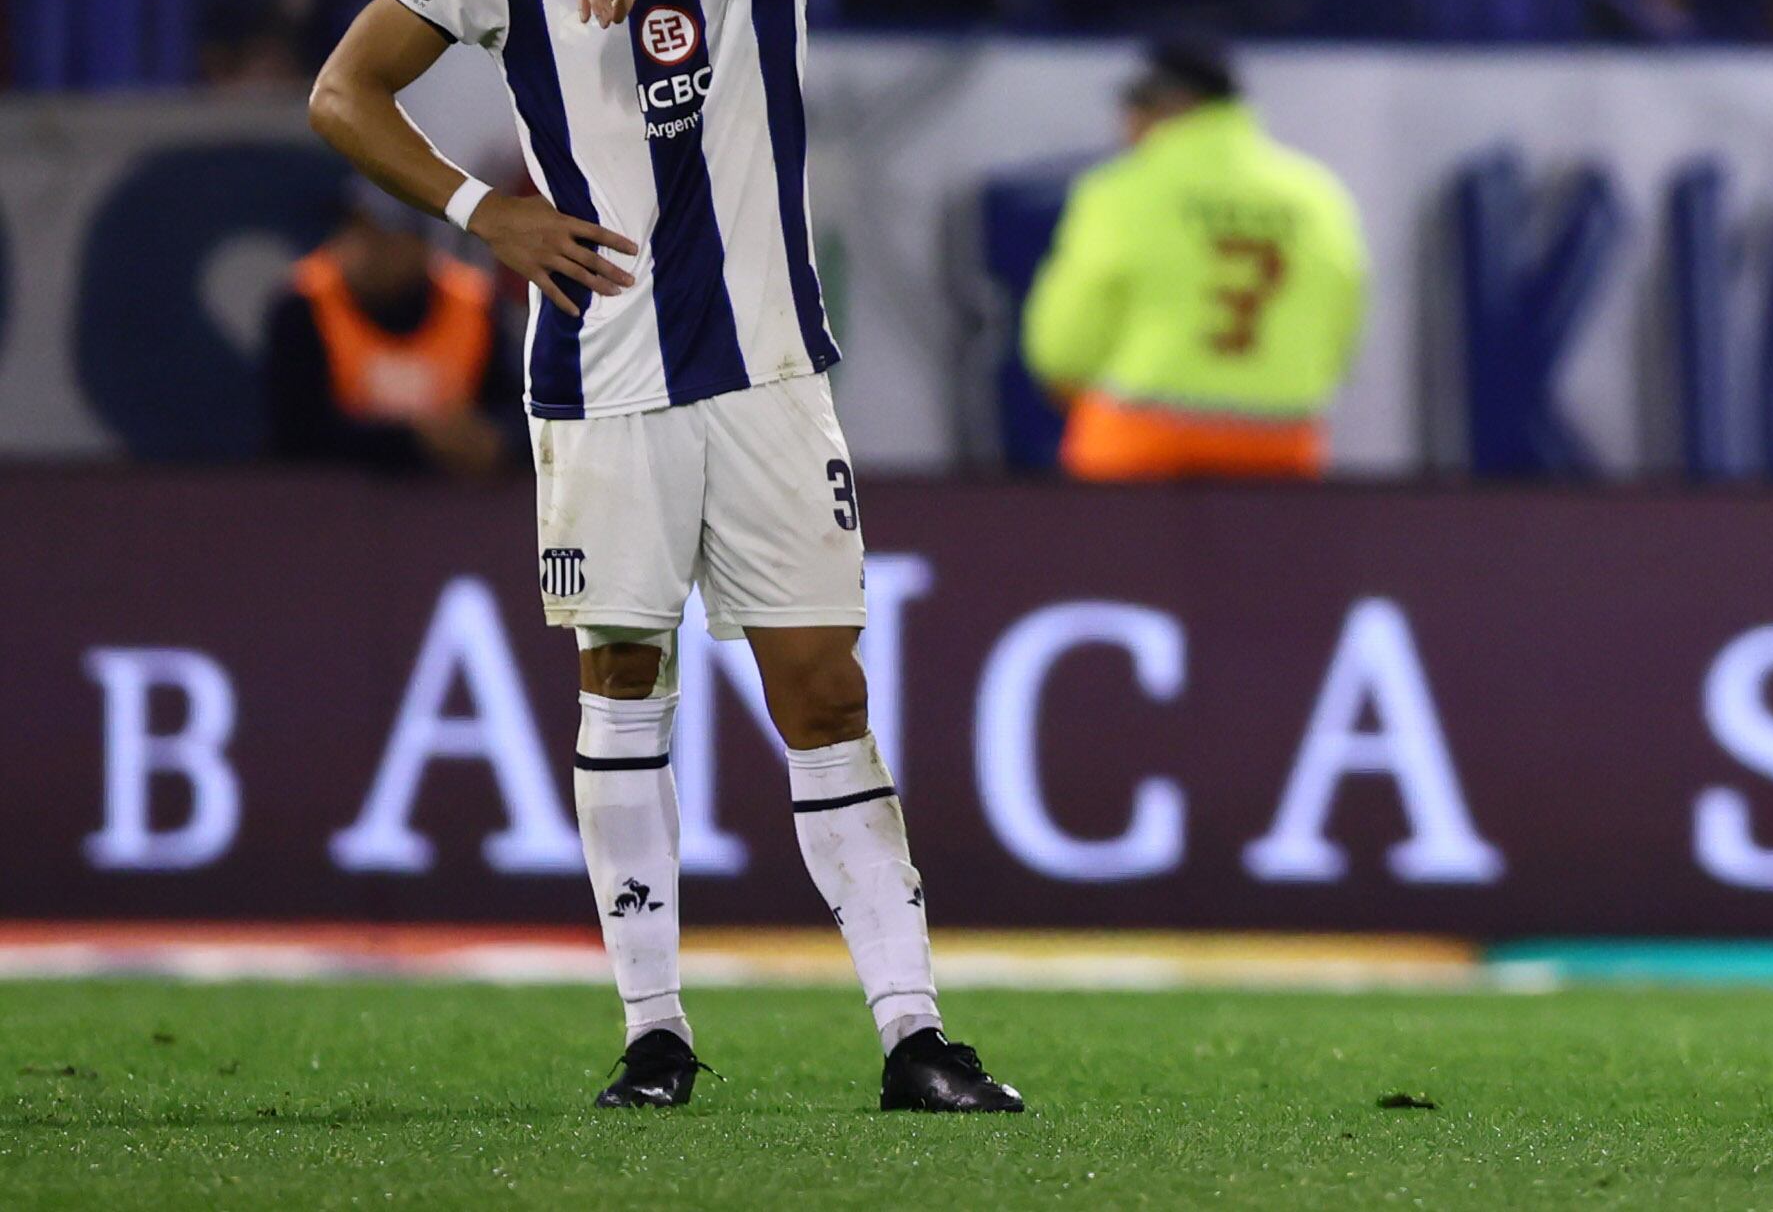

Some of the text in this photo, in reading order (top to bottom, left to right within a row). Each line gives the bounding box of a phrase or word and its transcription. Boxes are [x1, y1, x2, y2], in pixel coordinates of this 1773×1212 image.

[637, 65, 714, 114] ICBC
[645, 110, 703, 140] Argent
[1207, 228, 1287, 356] 3
[82, 552, 1510, 884] BANCA
